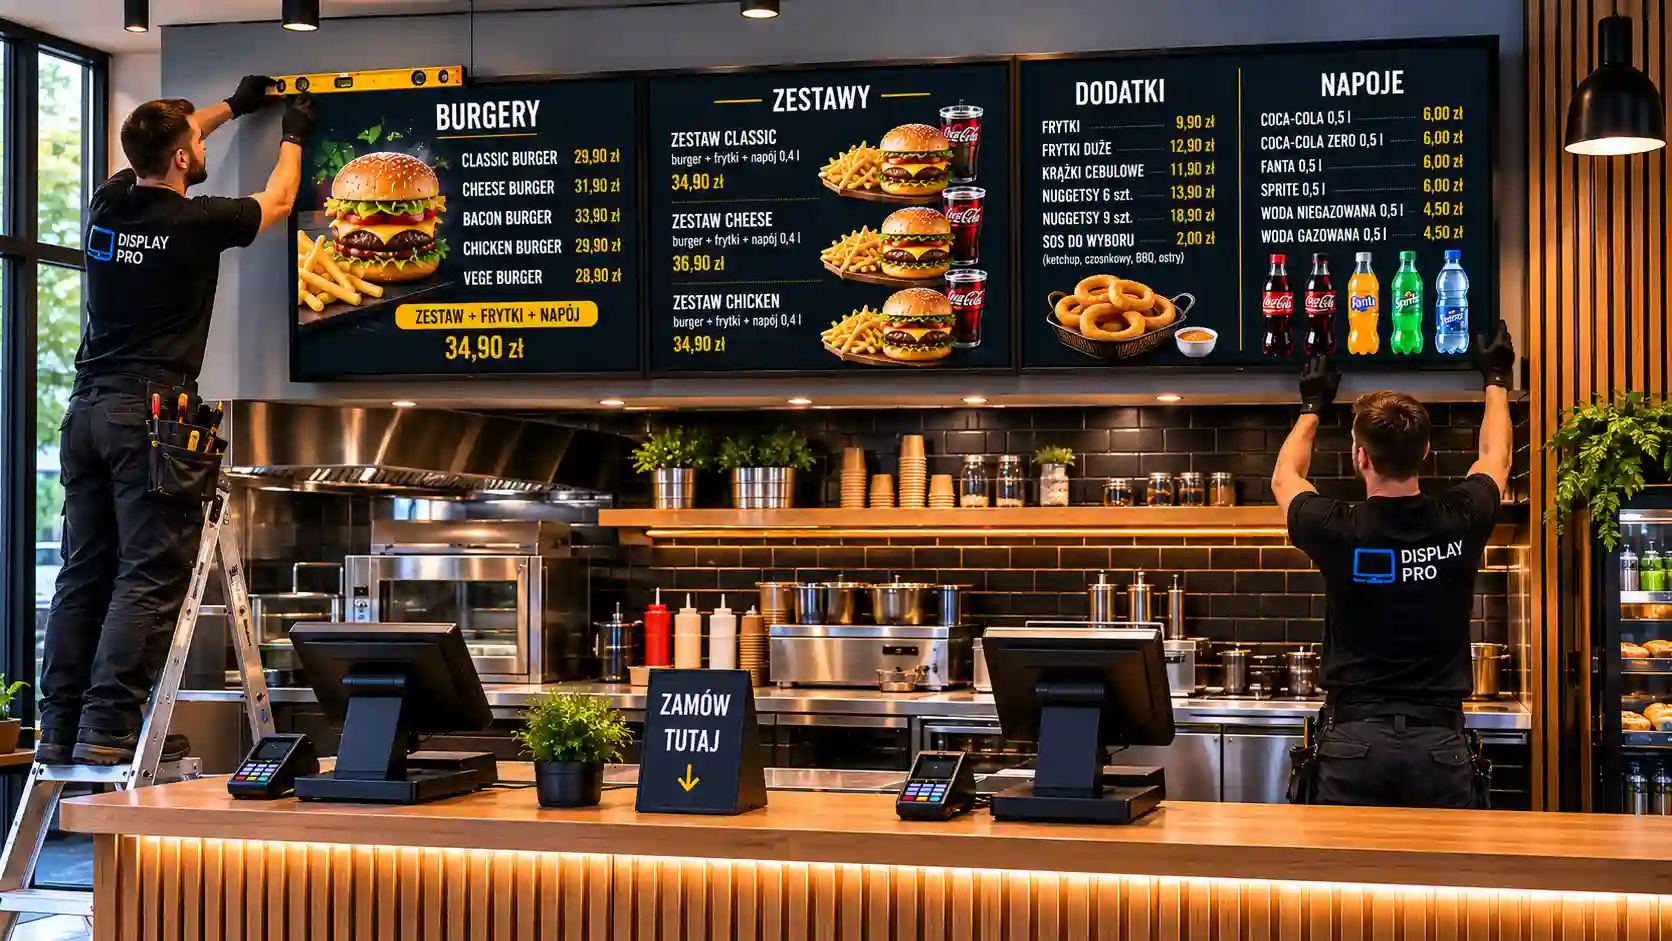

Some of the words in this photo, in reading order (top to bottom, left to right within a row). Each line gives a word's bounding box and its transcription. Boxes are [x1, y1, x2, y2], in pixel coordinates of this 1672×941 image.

[1076, 79, 1164, 105] DODATKI
[1322, 70, 1404, 96] NAPOJE
[773, 85, 870, 112] ZESTAWY
[437, 100, 540, 130] BURGERY
[1043, 120, 1079, 133] FRYTKI
[1177, 115, 1201, 130] 9,90
[1206, 115, 1214, 128] zł
[1261, 112, 1323, 126] COCA-COLA
[1328, 111, 1344, 125] 0,5
[1424, 106, 1449, 122] 6,00
[1453, 106, 1463, 119] zł
[671, 131, 720, 147] ZESTAW
[725, 129, 776, 145] CLASSIC
[1043, 143, 1079, 156] FRYTKI
[1084, 140, 1111, 155] DUŻE
[1171, 139, 1201, 153] 12,90
[1205, 138, 1214, 151] zł
[1261, 135, 1324, 150] COCA-COLA
[1328, 134, 1355, 147] ZERO
[1360, 133, 1376, 148] 0,5
[1424, 131, 1449, 146] 6,00
[1454, 130, 1463, 143] zł
[462, 152, 508, 167] CLASSIC
[513, 151, 557, 165] BURGER
[575, 149, 606, 164] 29,90
[610, 149, 619, 162] zł
[672, 154, 701, 167] burger
[715, 152, 738, 165] frytki
[751, 153, 776, 164] napój
[780, 150, 793, 162] 0,4
[1261, 160, 1295, 173] FANTA
[1299, 159, 1315, 173] 0,5
[1424, 155, 1449, 170] 6,00
[1454, 155, 1463, 167] zł
[1043, 164, 1081, 182] KRĄŻKI
[1086, 164, 1144, 178] CEBULOWE
[1171, 162, 1201, 177] 11,90
[1206, 162, 1214, 174] zł
[463, 181, 505, 196] CHEESE
[509, 180, 554, 195] BURGER
[575, 179, 607, 194] 31,90
[611, 179, 620, 192] zł
[672, 174, 709, 191] 34,90
[714, 174, 724, 188] zł
[1261, 183, 1299, 196] SPRITE
[1303, 182, 1319, 197] 0,5
[1424, 179, 1449, 194] 6,00
[1454, 178, 1463, 191] zł
[1043, 188, 1099, 202] NUGGETSY
[1103, 188, 1110, 201] 6
[1114, 189, 1132, 200] szt.
[1171, 185, 1201, 200] 13,90
[1206, 185, 1214, 198] zł
[464, 211, 501, 226] BACON
[506, 210, 551, 225] BURGER
[575, 208, 607, 224] 33,90
[611, 208, 620, 221] zł
[1043, 212, 1099, 225] NUGGETSY
[1104, 211, 1110, 224] 9
[1114, 212, 1132, 224] szt.
[1171, 208, 1201, 222] 18,90
[1206, 208, 1214, 221] zł
[1261, 206, 1293, 219] WODA
[1298, 204, 1376, 219] NIEGAZOWANA
[1381, 204, 1397, 219] 0,5
[1424, 202, 1449, 217] 4,50
[1454, 202, 1463, 215] zł
[672, 213, 721, 228] ZESTAW
[726, 212, 772, 227] CHEESE
[118, 233, 169, 249] DISPLAY
[673, 236, 702, 248] burger
[715, 234, 739, 247] frytki
[752, 233, 777, 246] napój
[780, 233, 794, 245] 0,4
[1043, 235, 1064, 248] SOS
[1068, 235, 1082, 248] DO
[1087, 234, 1134, 247] WYBORU
[1177, 231, 1202, 246] 2,00
[1206, 231, 1215, 244] zł
[1261, 230, 1293, 243] WODA
[1298, 228, 1359, 242] GAZOWANA
[1364, 228, 1380, 242] 0,5
[1424, 226, 1449, 240] 4,50
[1454, 226, 1463, 238] zł
[464, 240, 512, 255] CHICKEN
[516, 239, 561, 254] BURGER
[576, 238, 608, 254] 29,90
[612, 238, 621, 251] zł
[116, 249, 143, 264] PRO
[673, 255, 710, 273] 36,90
[714, 256, 724, 270] zł
[1043, 254, 1082, 266] (ketchup,
[1136, 252, 1156, 263] BBQ,
[1159, 252, 1184, 264] ostry)
[464, 271, 492, 285] VEGE
[497, 270, 542, 284] BURGER
[576, 268, 608, 283] 28,90
[612, 268, 621, 281] zł
[673, 294, 721, 309] ZESTAW
[726, 294, 779, 309] CHICKEN
[416, 309, 463, 324] ZESTAW
[482, 308, 523, 323] FRYTKI
[541, 304, 579, 321] NAPÓJ
[674, 316, 703, 330] burger
[716, 315, 740, 328] frytki
[753, 314, 777, 328] napój
[781, 314, 795, 327] 0,4
[446, 335, 502, 362] 34,90
[509, 338, 524, 358] zł
[674, 336, 710, 354] 34,90
[715, 337, 725, 351] zł
[1401, 540, 1463, 563] DISPLAY
[1402, 565, 1437, 582] PRO
[660, 689, 731, 716] ZAMÓW
[664, 729, 720, 752] TUTAJ
